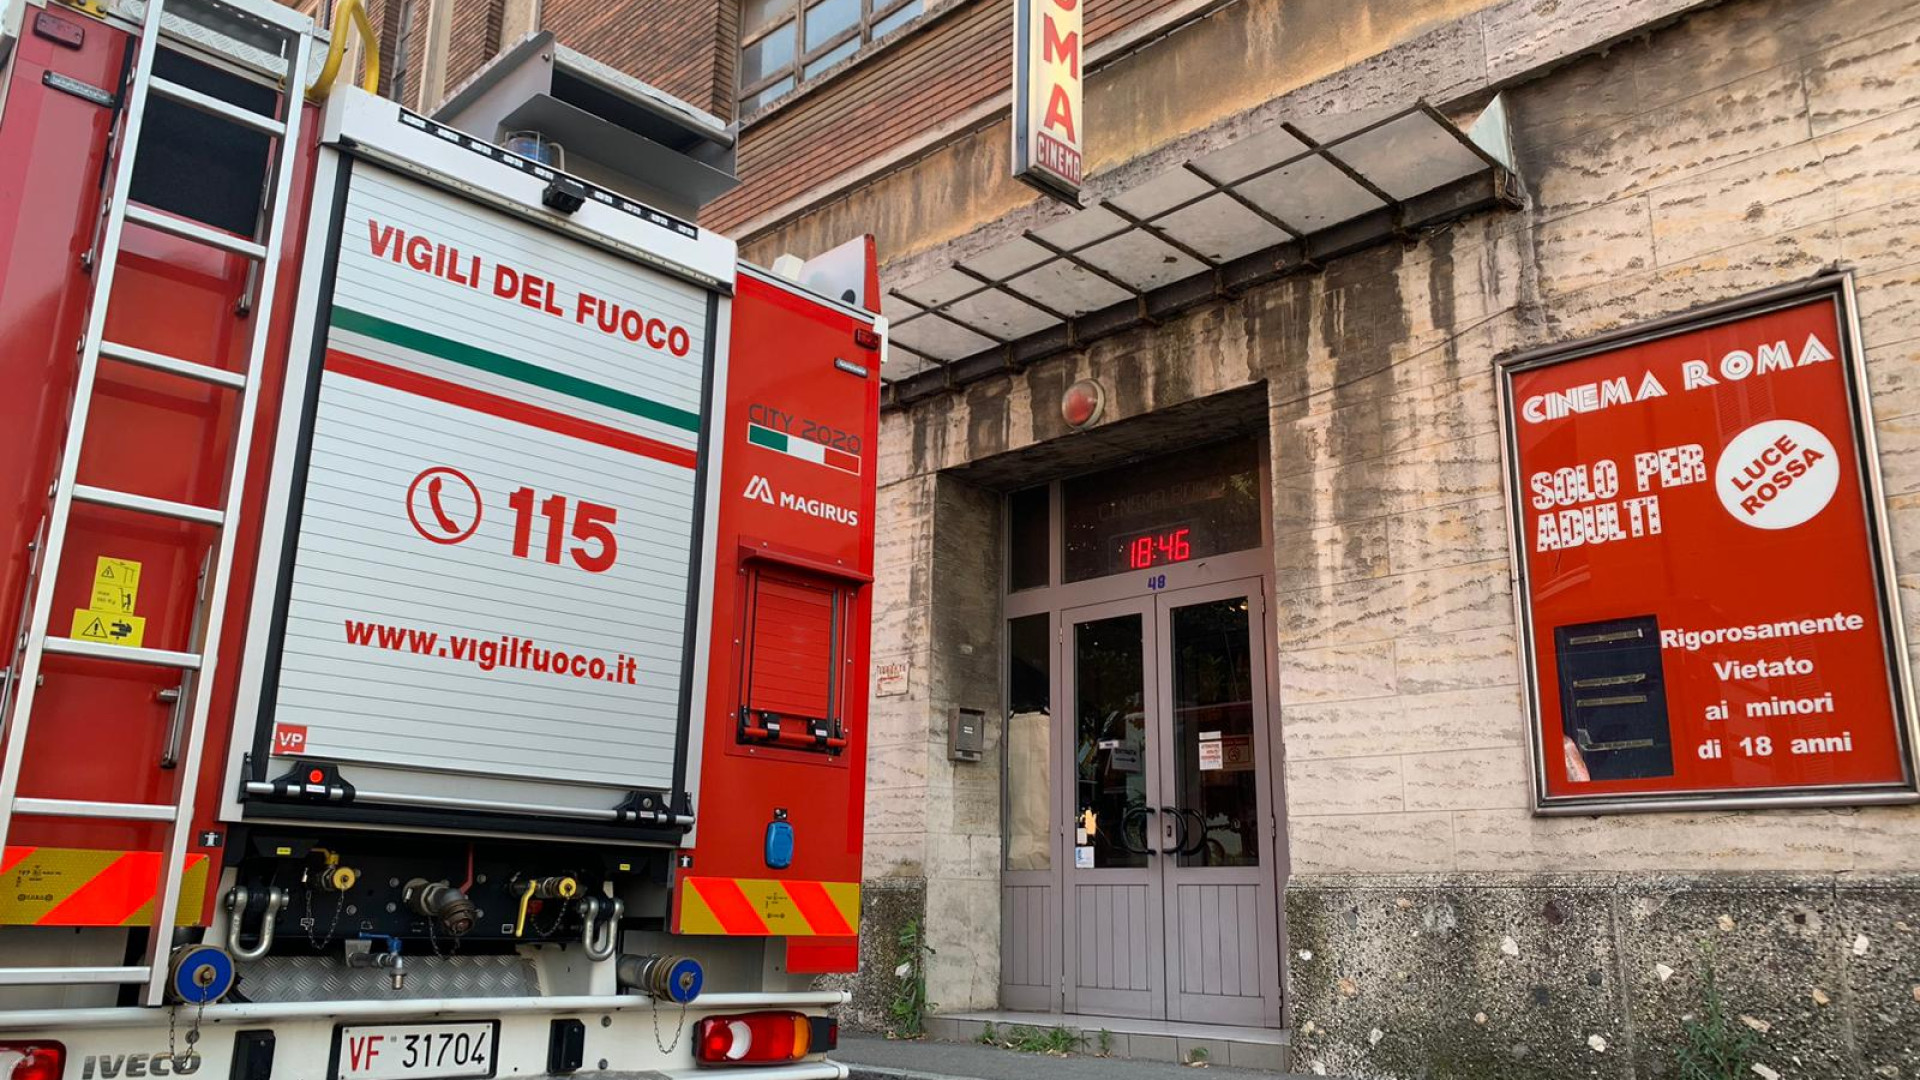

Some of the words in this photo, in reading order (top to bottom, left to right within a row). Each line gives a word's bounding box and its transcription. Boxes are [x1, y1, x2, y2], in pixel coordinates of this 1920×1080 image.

[1043, 0, 1078, 144] MA
[1038, 136, 1080, 182] CINEMA
[368, 219, 481, 289] VIGILI
[493, 263, 564, 317] DEL
[576, 292, 690, 357] FUOCO
[1522, 370, 1668, 424] CINEMA
[1681, 332, 1835, 391] ROMA
[749, 403, 794, 433] CITY
[802, 419, 861, 455] 2020
[1530, 459, 1619, 510] SOLO
[1634, 443, 1707, 493] PER
[1731, 434, 1798, 492] LUCE
[1740, 447, 1825, 516] ROSSA
[509, 486, 618, 573] 115
[780, 491, 858, 526] MAGIRUS
[1537, 495, 1662, 552] ADULTI
[1130, 529, 1190, 569] 18:46
[1148, 574, 1166, 590] 48
[345, 619, 637, 685] www.vigilfuoco.it
[1661, 612, 1865, 651] Rigorosamente
[1713, 656, 1814, 681] Vietato
[1705, 700, 1729, 720] ai
[1746, 692, 1835, 718] minori
[279, 731, 304, 747] VP
[1698, 739, 1722, 760] di
[1739, 736, 1773, 757] 18
[1790, 732, 1852, 754] anni
[82, 1051, 201, 1079] IVECO
[349, 1036, 385, 1072] VF
[402, 1032, 486, 1068] 31704
